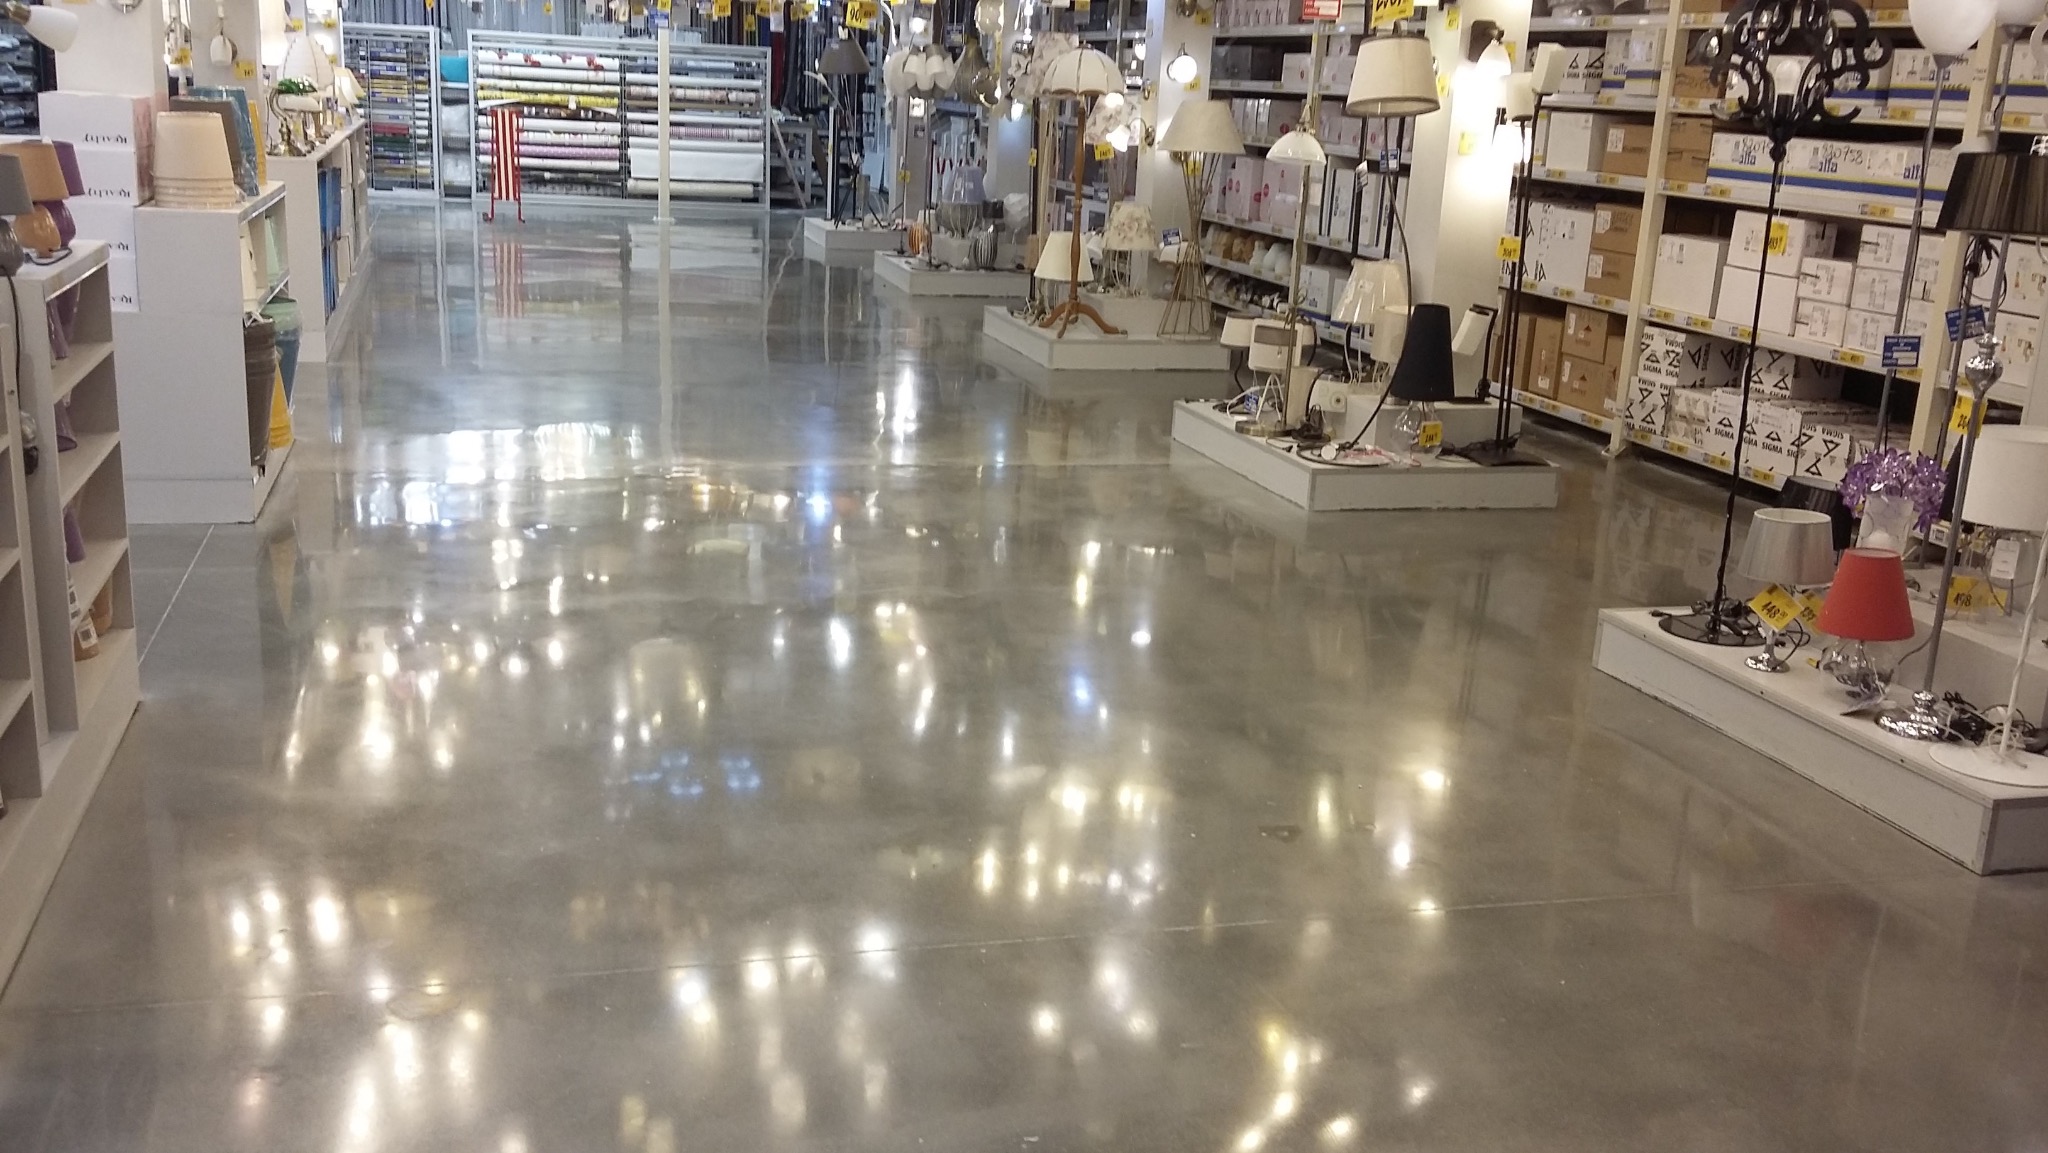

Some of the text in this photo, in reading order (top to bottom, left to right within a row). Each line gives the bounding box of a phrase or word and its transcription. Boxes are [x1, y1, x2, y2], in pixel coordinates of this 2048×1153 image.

[1738, 151, 1756, 165] alfa
[1818, 158, 1838, 173] alfa
[1903, 162, 1920, 180] alf
[1643, 363, 1662, 375] SIGMA
[1714, 427, 1735, 441] SIGMA
[1821, 426, 1844, 440] SIGMA
[1761, 442, 1783, 455] SIGMA
